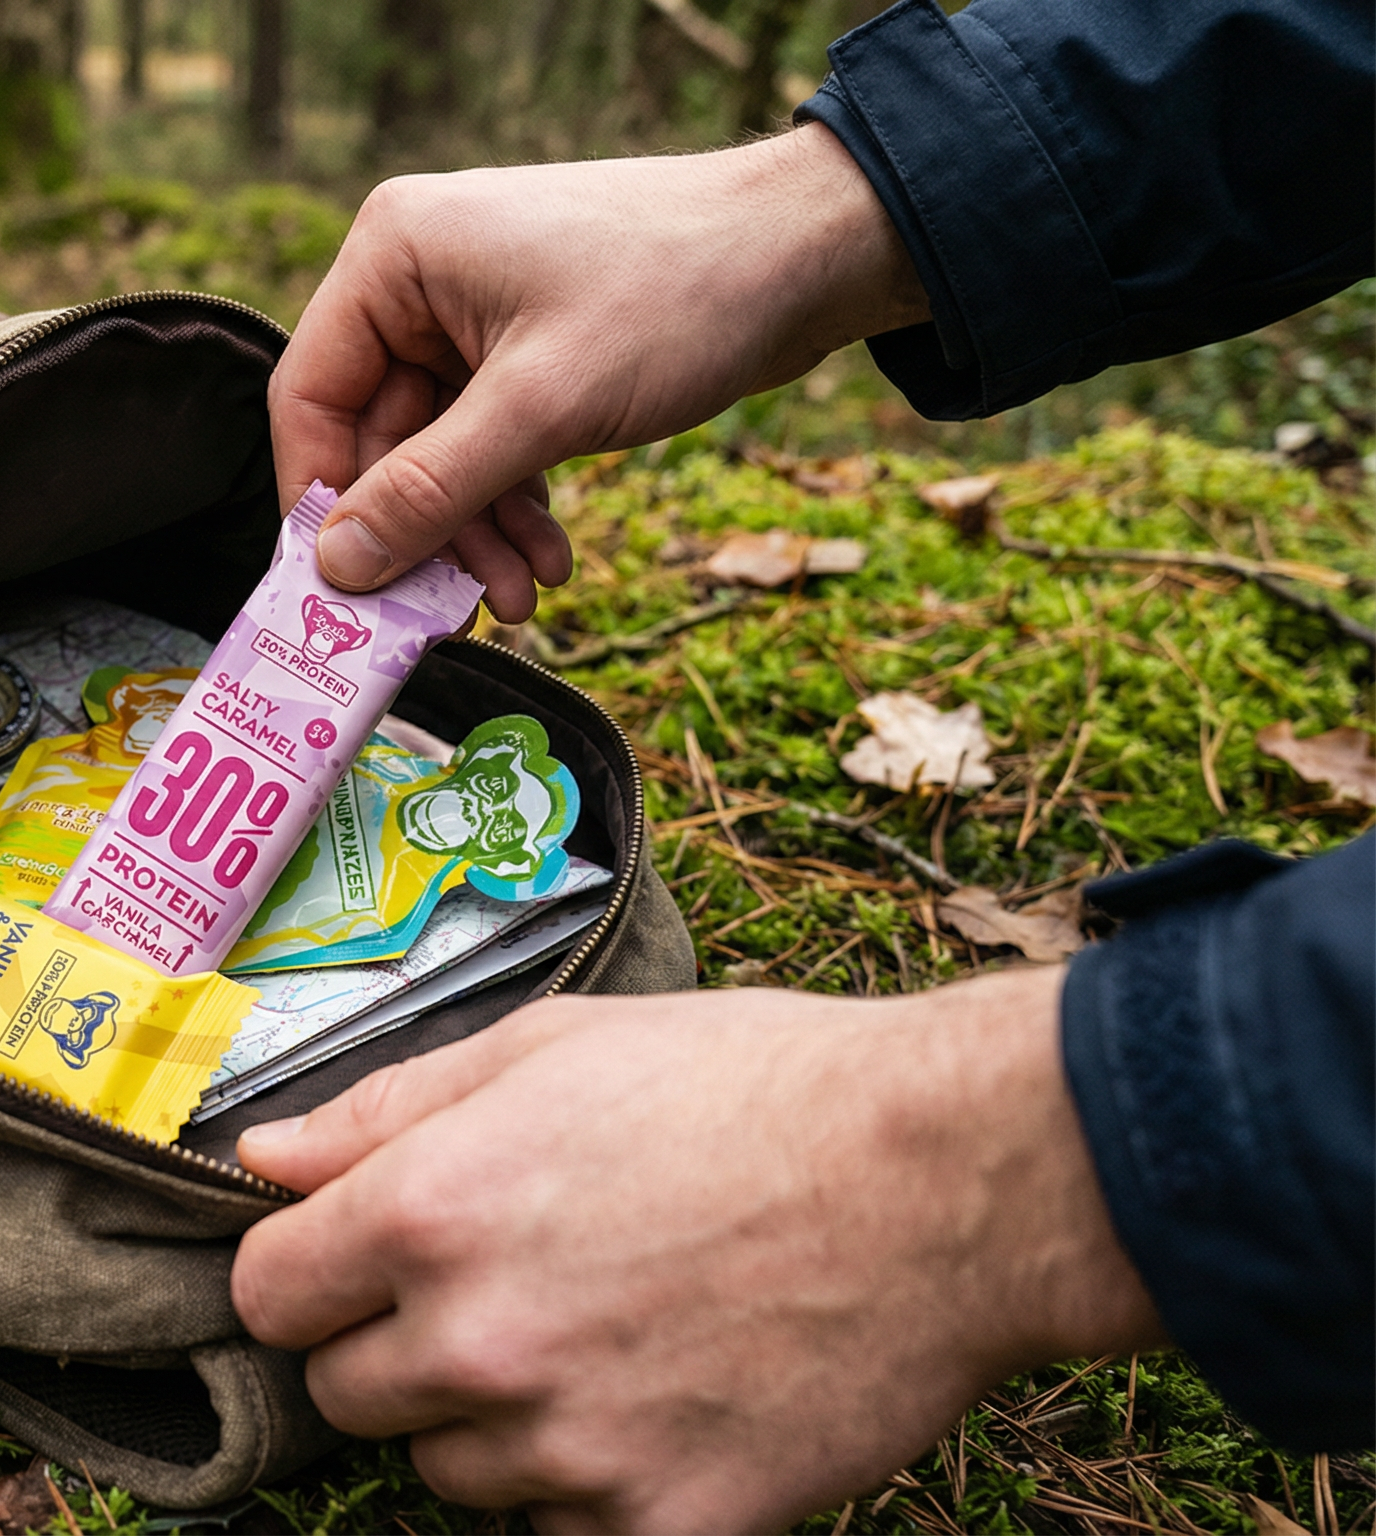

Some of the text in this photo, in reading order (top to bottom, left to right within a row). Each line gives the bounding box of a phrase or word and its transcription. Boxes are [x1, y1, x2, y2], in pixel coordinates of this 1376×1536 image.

[213, 671, 280, 719] SALTY
[259, 637, 349, 697] 30% PROTEIN
[201, 692, 297, 763] CARAMEL
[127, 730, 290, 890] 30%
[97, 843, 219, 933] PROTEIN
[104, 893, 162, 939] VANILA
